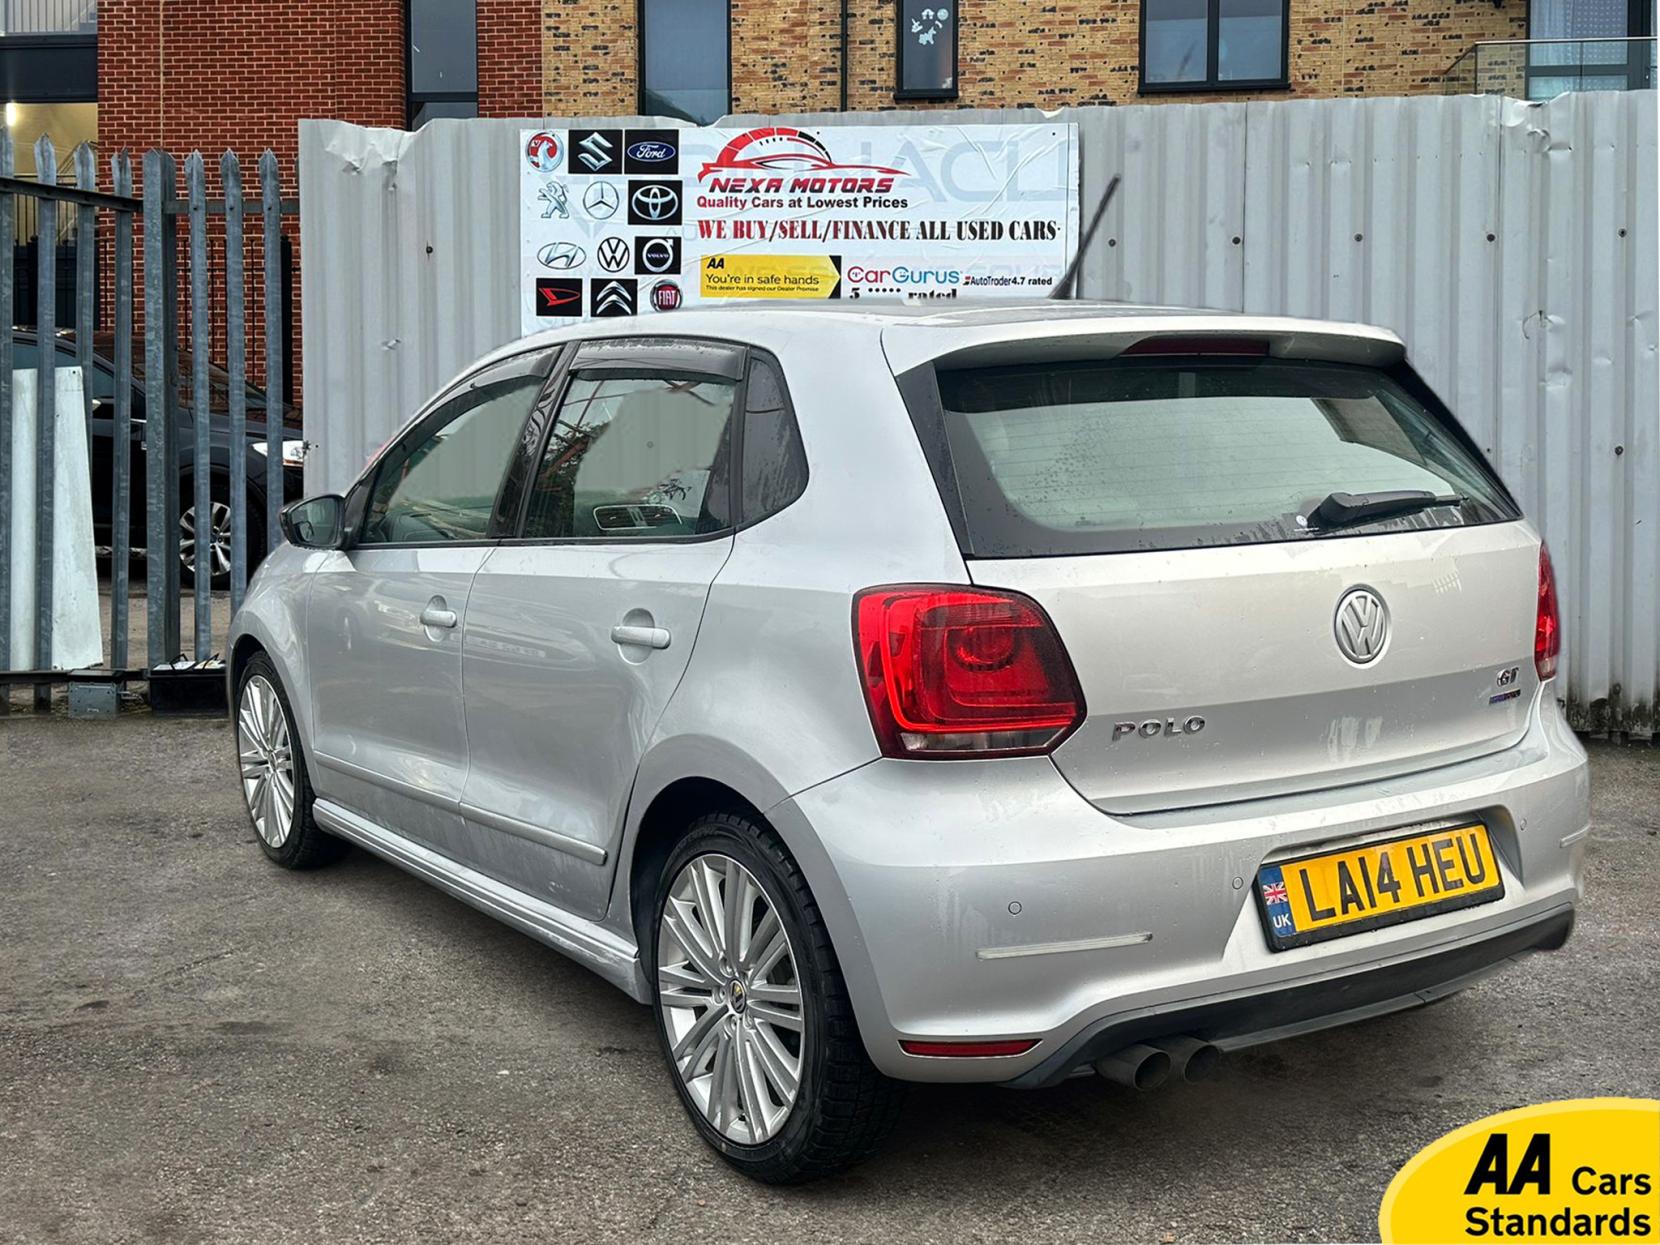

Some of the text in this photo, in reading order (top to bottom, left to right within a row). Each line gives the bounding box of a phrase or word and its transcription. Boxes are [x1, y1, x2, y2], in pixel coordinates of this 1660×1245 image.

[636, 143, 666, 159] Ford
[709, 178, 895, 193] NEXA MOTORS
[697, 196, 908, 211] Quality Cars at Lowest Prices
[697, 220, 727, 239] WE
[916, 220, 951, 240] ALL
[956, 220, 1004, 240] USED
[706, 258, 725, 269] AA
[706, 273, 819, 285] You're in safe hands
[847, 266, 960, 284] CarGurus
[1028, 276, 1053, 286] rated
[658, 290, 676, 305] FIAT
[849, 287, 860, 299] 5
[1496, 666, 1519, 687] GT
[1111, 715, 1207, 742] POLO
[1300, 833, 1486, 922] LA14 HEU
[1272, 913, 1292, 929] UK
